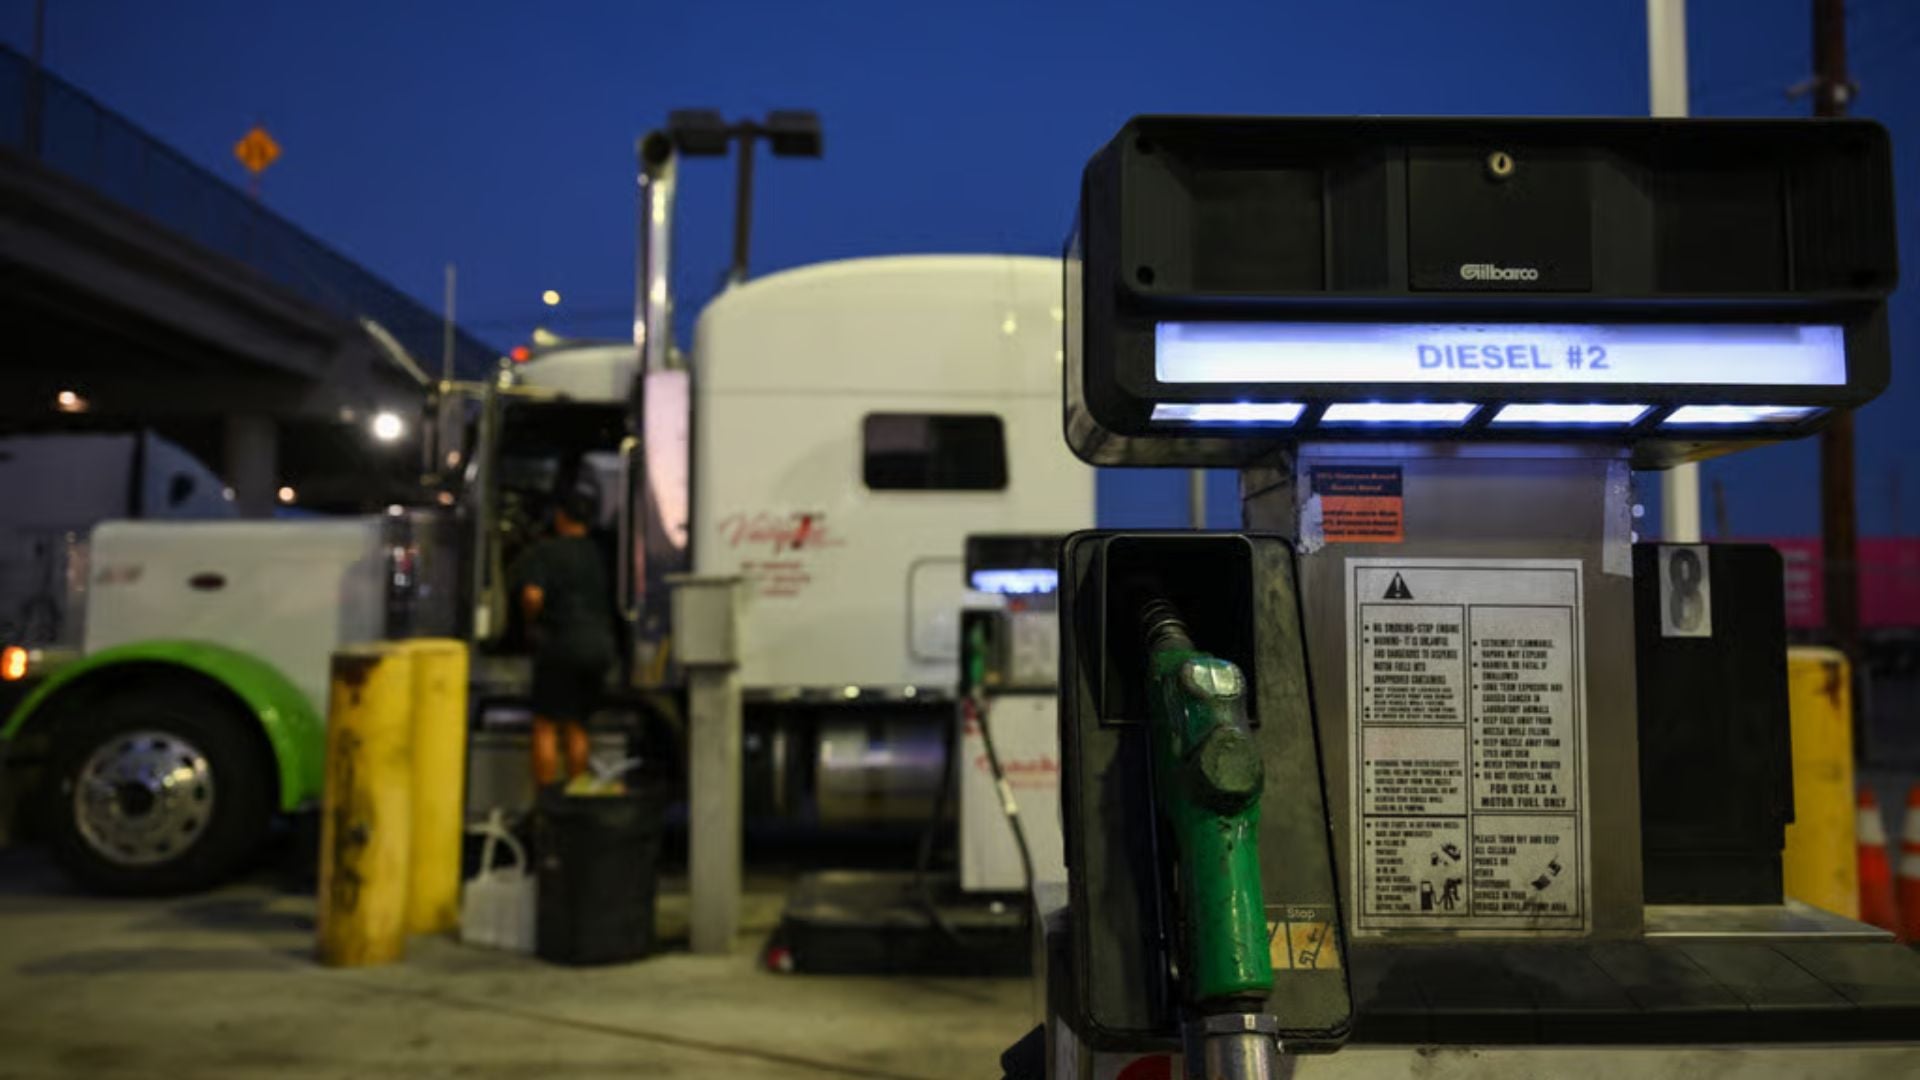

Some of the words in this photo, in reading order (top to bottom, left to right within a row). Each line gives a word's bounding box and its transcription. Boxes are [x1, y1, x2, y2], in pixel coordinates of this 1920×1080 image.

[1460, 264, 1539, 280] Gilbarco
[1417, 344, 1552, 369] DIESEL
[1566, 344, 1609, 369] #2
[1669, 548, 1704, 632] 8
[1490, 784, 1508, 794] FOR
[1512, 784, 1530, 794] USE
[1534, 784, 1547, 794] AS
[1550, 784, 1558, 794] A
[1482, 797, 1514, 807] MOTOR
[1518, 797, 1540, 807] FUEL
[1543, 797, 1566, 807] ONLY
[1287, 908, 1315, 920] Stop
